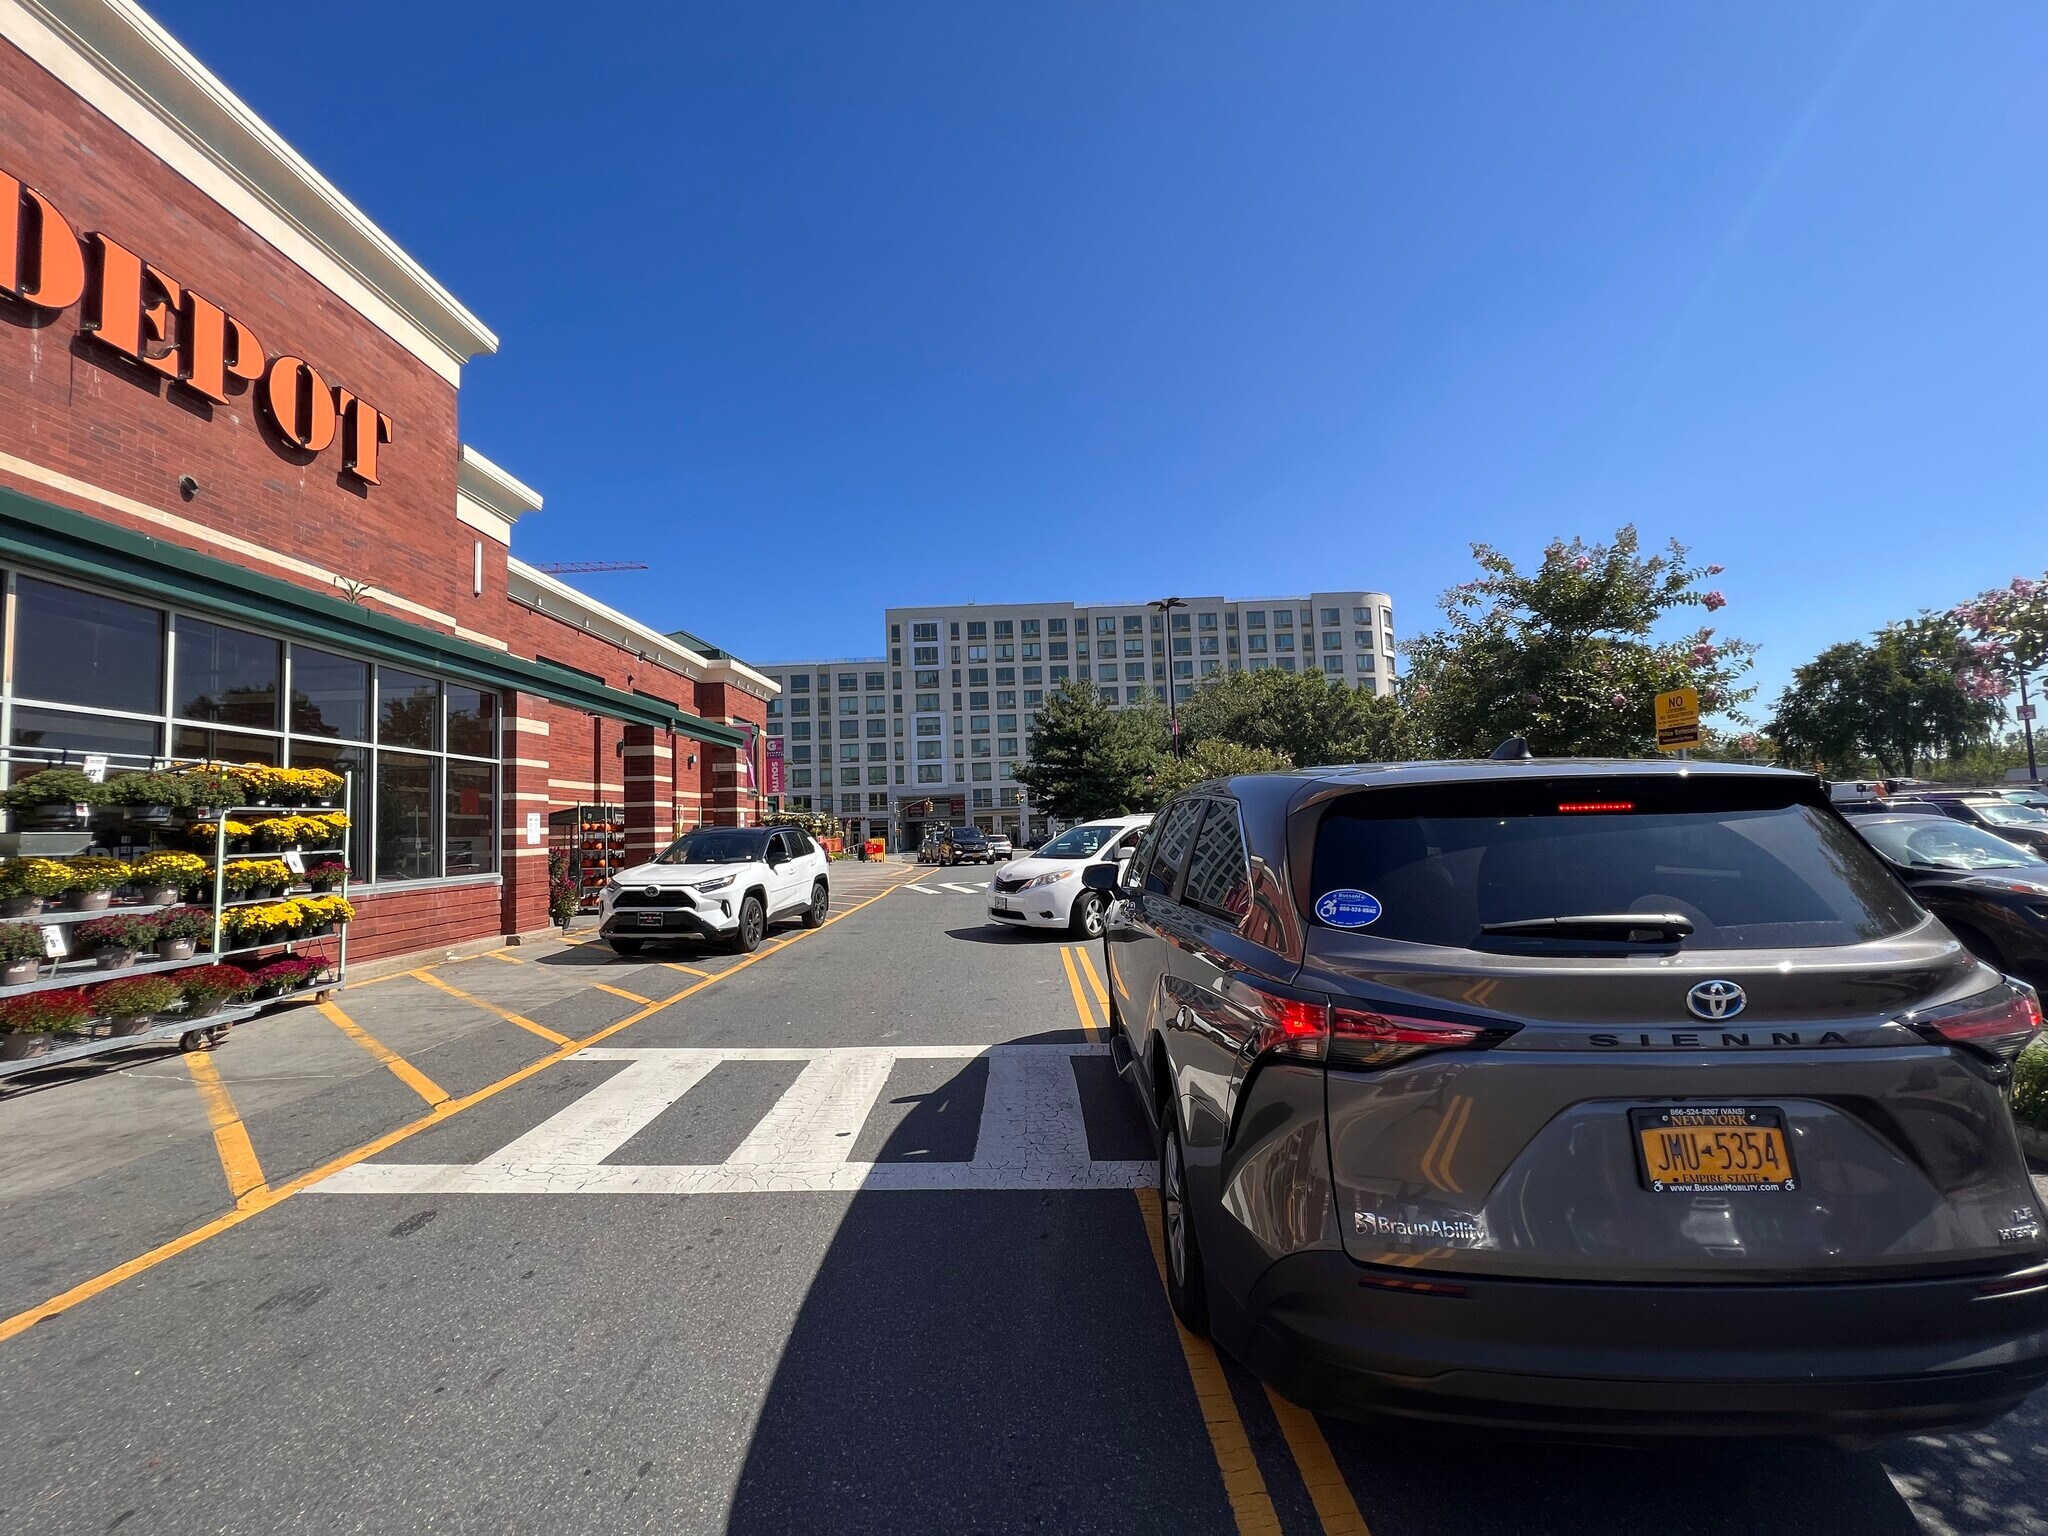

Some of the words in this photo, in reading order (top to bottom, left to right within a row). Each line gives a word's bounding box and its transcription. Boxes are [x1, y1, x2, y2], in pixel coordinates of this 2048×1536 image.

[0, 167, 393, 486] DEPOT
[1668, 696, 1683, 707] NO
[771, 761, 780, 792] SOUTH
[1589, 1031, 1849, 1047] SIENNA
[1671, 1115, 1706, 1126] NEW
[1709, 1115, 1749, 1126] YORK
[1659, 1133, 1701, 1171] JMU
[1714, 1132, 1780, 1170] 5354
[1682, 1174, 1724, 1183] EMPIRE
[1727, 1173, 1760, 1182] STATE
[1379, 1216, 1485, 1241] BraunAbility
